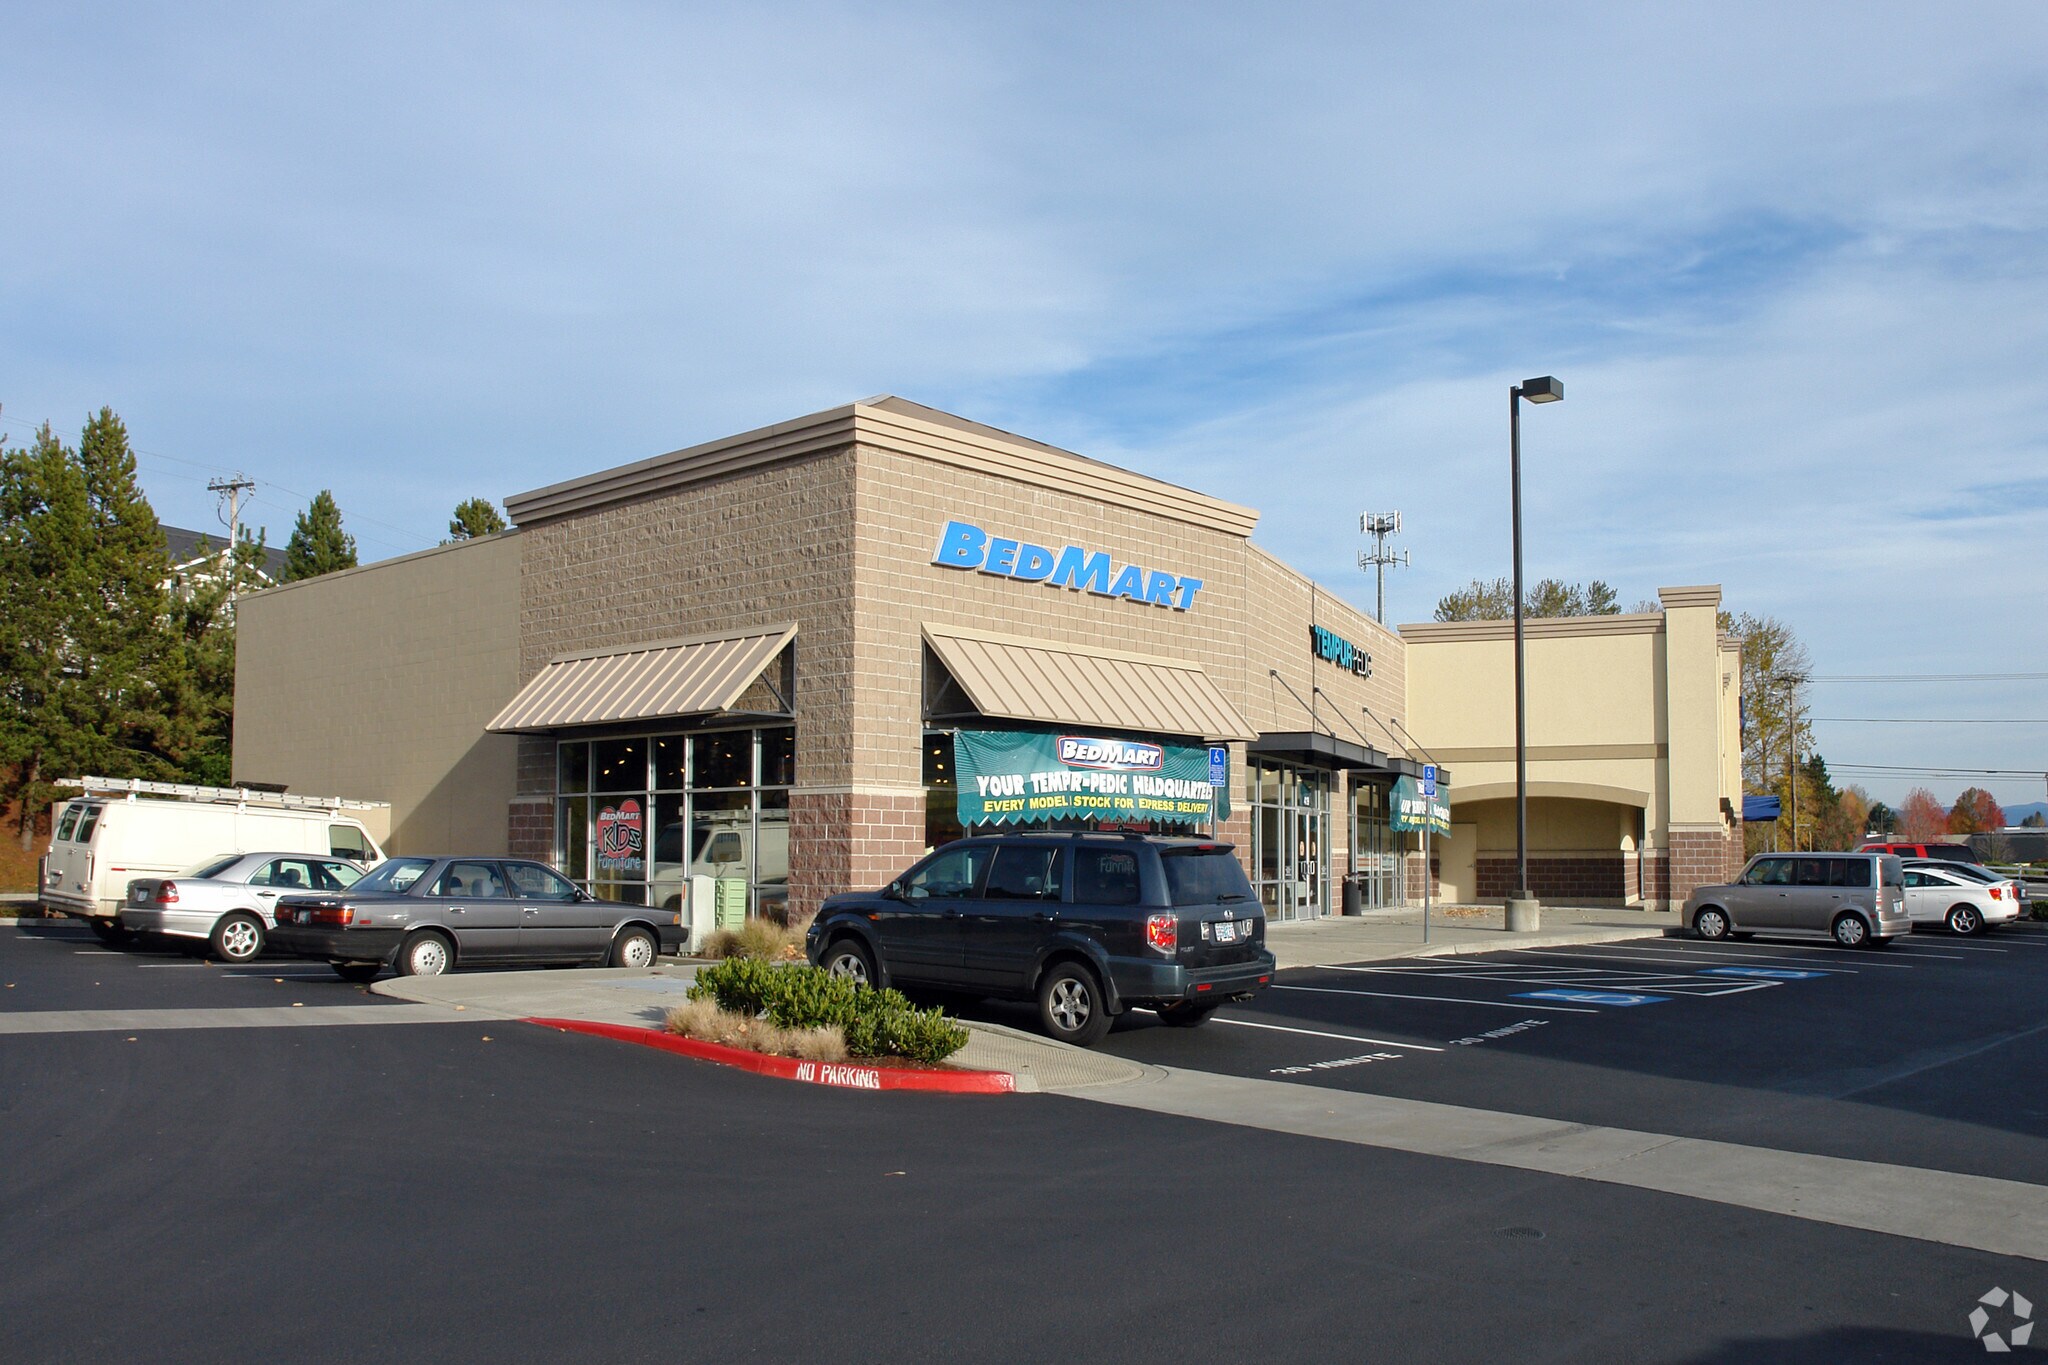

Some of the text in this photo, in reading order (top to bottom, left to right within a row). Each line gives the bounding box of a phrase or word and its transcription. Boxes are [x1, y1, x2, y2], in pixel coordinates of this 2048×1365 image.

[931, 520, 1204, 611] BEDMART
[1062, 740, 1160, 765] BEDMART
[976, 774, 1025, 797] YOUR
[984, 798, 1025, 812] EVERY
[1029, 796, 1068, 810] MODEL
[1073, 796, 1111, 808] STOCK
[1114, 797, 1134, 809] FOR
[597, 853, 641, 872] Furniture
[796, 1063, 880, 1089] NO PARKING
